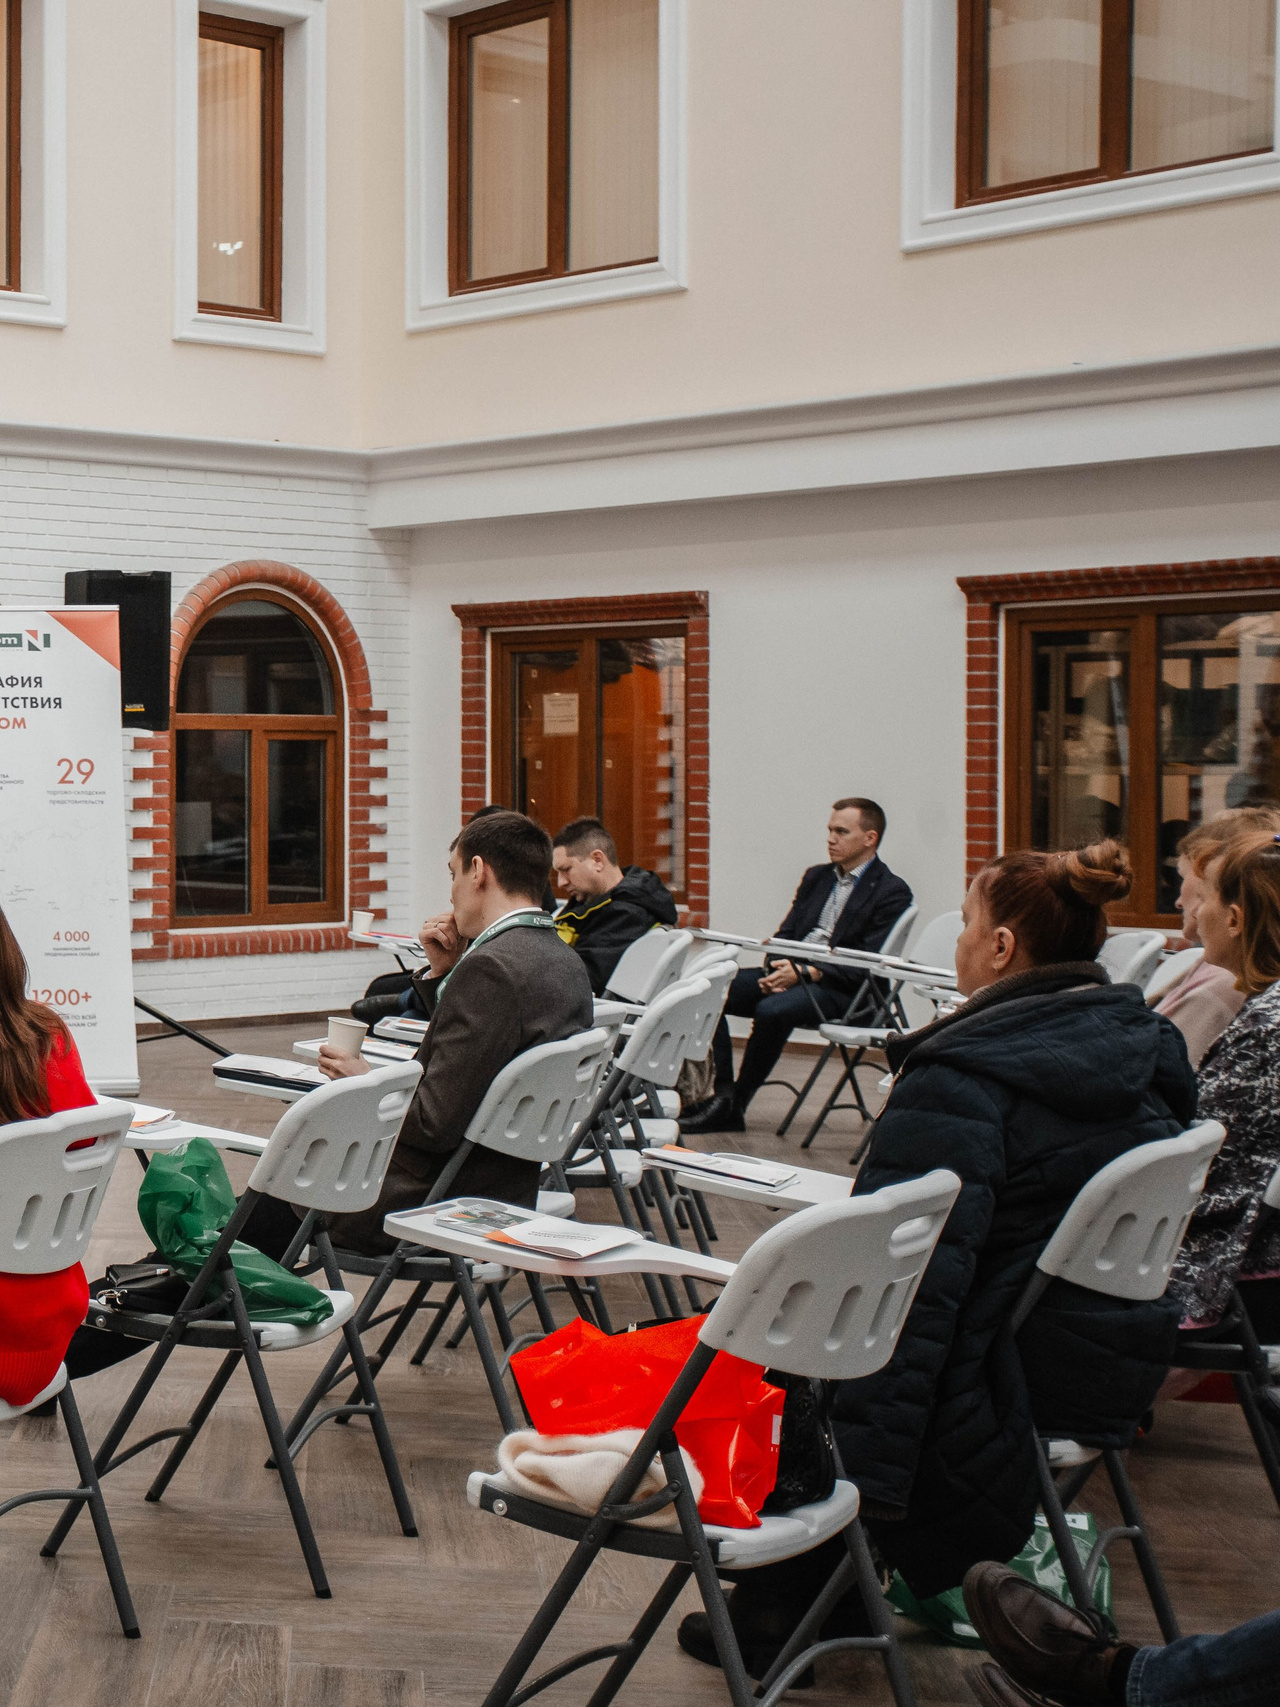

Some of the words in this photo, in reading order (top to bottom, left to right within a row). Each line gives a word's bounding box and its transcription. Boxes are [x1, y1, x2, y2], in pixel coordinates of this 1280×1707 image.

[56, 757, 95, 785] 29
[53, 931, 61, 942] 4
[64, 931, 90, 942] 000
[32, 988, 92, 1006] 1200+
